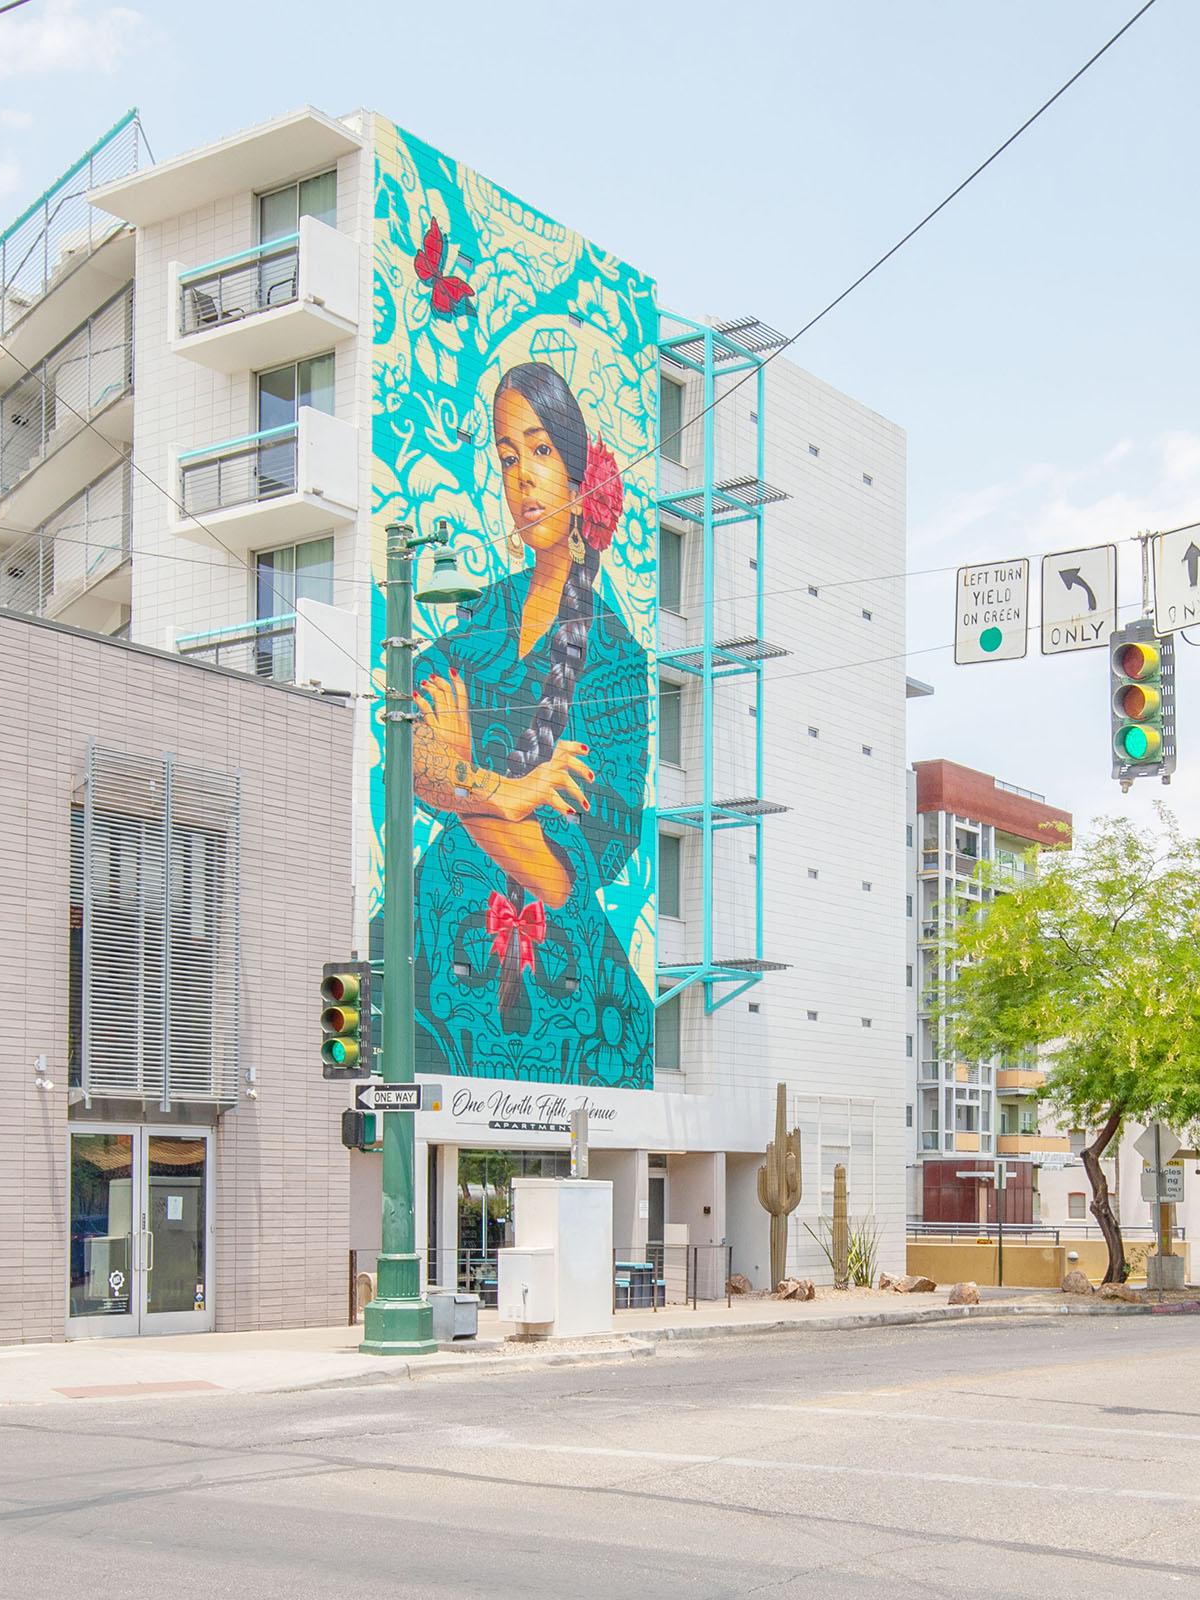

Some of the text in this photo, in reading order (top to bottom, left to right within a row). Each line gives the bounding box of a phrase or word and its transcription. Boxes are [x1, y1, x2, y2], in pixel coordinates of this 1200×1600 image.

[964, 567, 1022, 587] LEFT TURN
[973, 588, 1011, 606] YIELD
[963, 608, 1020, 626] ON GREEN
[1168, 603, 1196, 623] ON
[1051, 621, 1104, 645] ONLY
[374, 1092, 414, 1103] ONE WAY
[452, 1088, 618, 1124] One North Fifth Aenue
[1145, 1168, 1182, 1176] Veicles
